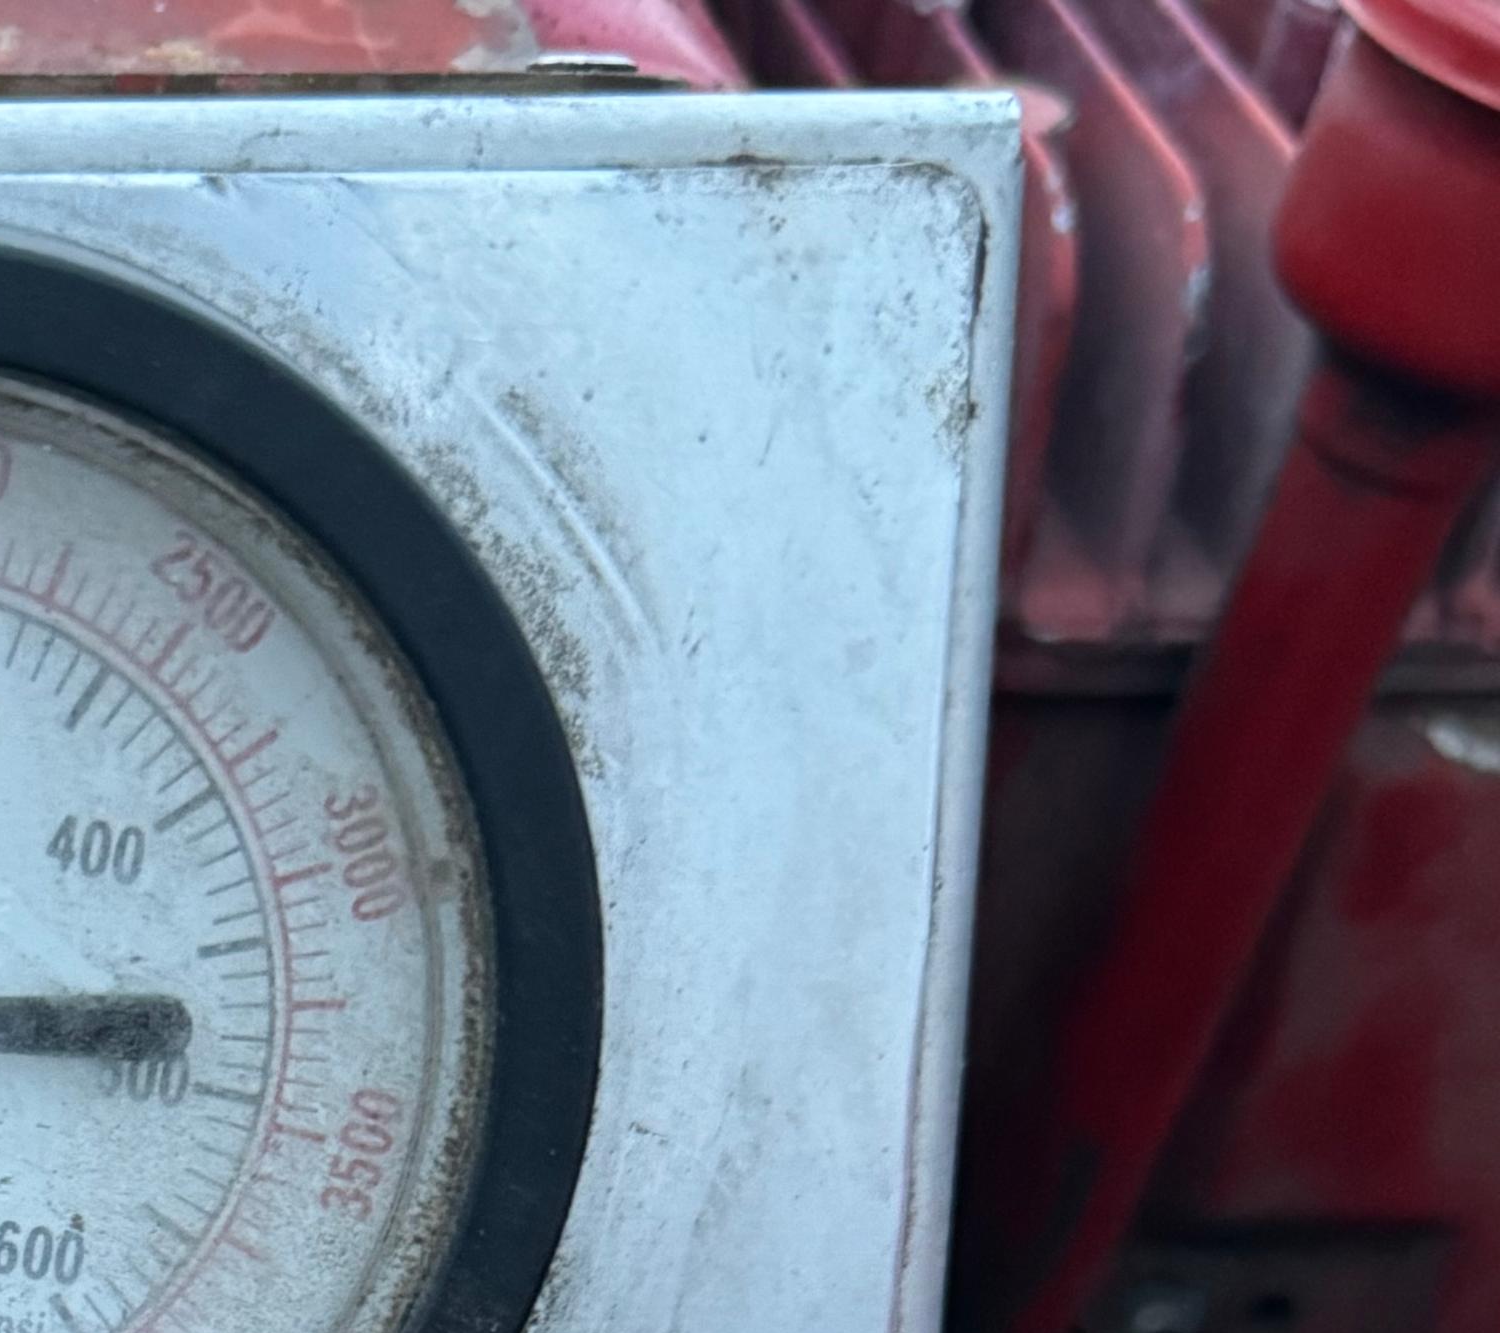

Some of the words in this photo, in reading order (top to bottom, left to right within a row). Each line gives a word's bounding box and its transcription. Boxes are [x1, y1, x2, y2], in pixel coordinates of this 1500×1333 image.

[150, 530, 279, 652] 2500
[46, 815, 146, 885] 400
[324, 785, 403, 922] 3000
[319, 1089, 397, 1220] 3500
